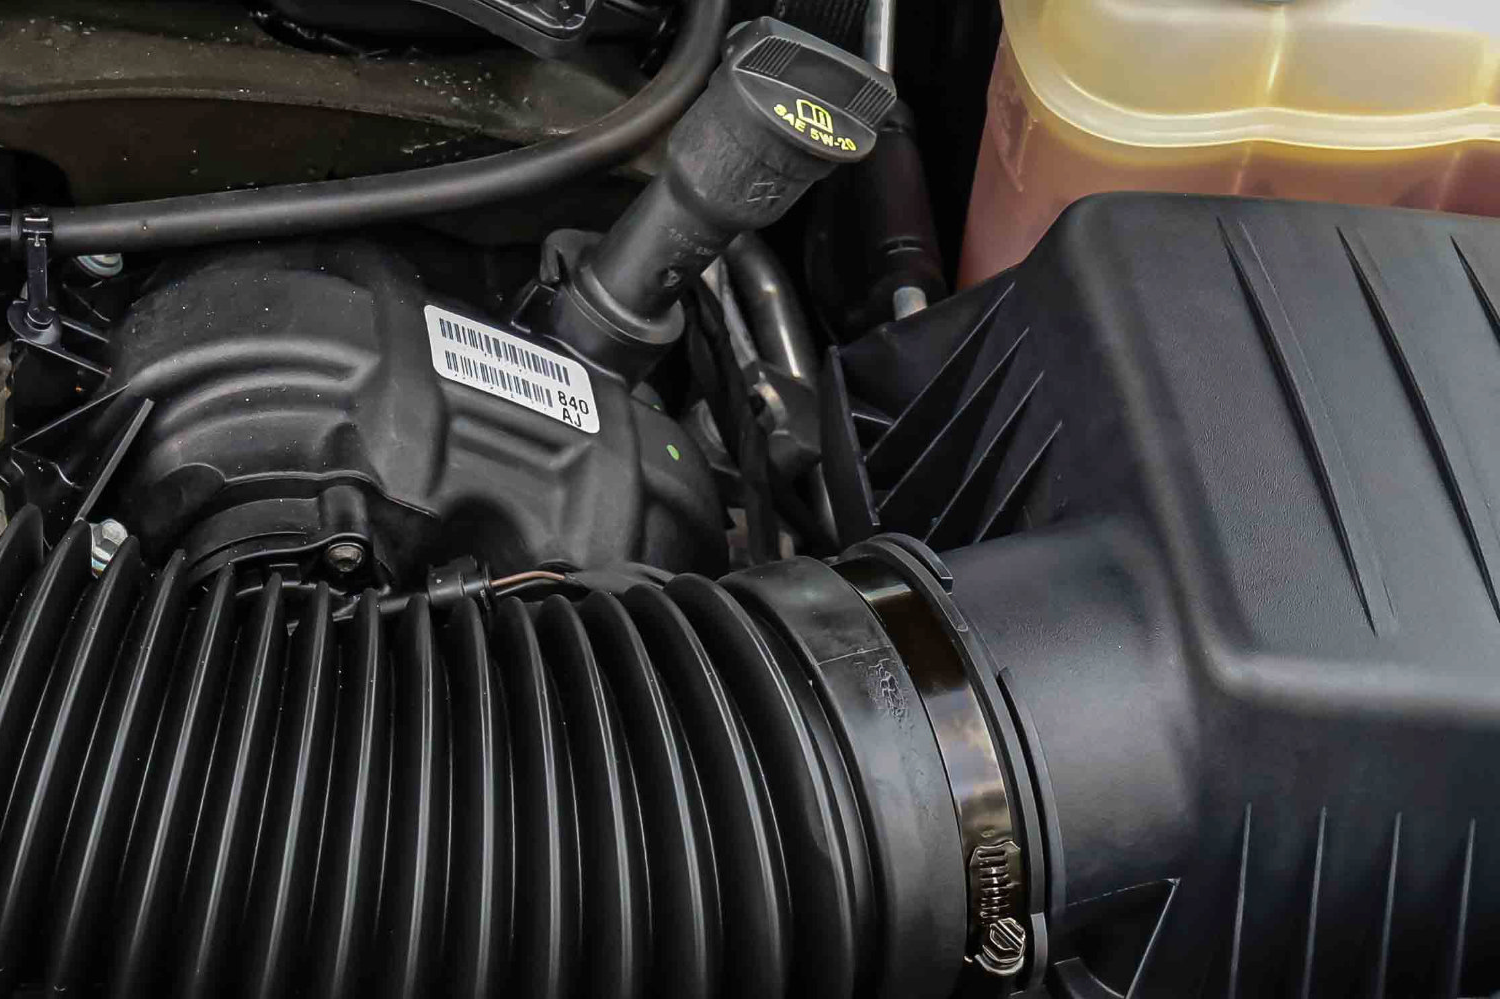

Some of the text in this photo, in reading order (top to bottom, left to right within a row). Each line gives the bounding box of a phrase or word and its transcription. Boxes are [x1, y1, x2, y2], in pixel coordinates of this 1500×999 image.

[773, 104, 857, 151] SAE 5W-20
[558, 391, 589, 415] 840
[563, 407, 582, 427] AJ
